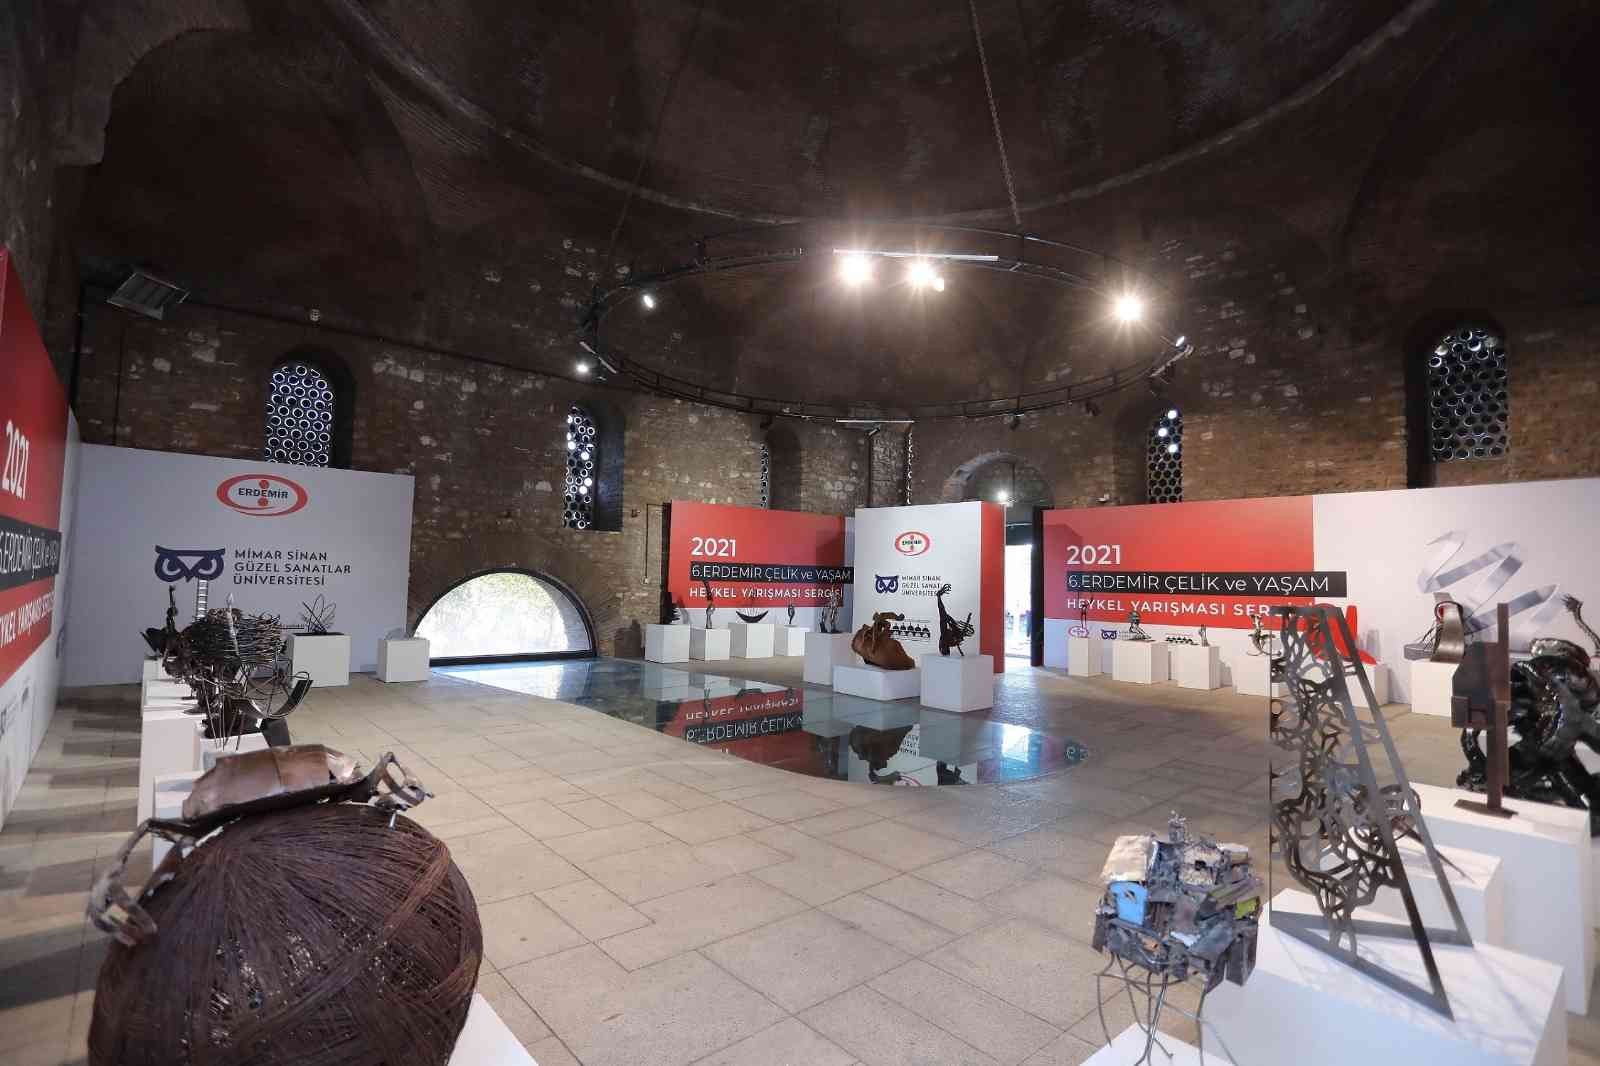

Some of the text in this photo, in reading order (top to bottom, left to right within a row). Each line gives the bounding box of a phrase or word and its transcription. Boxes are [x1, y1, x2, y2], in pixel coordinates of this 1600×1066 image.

[2, 419, 29, 500] 2021
[238, 488, 289, 499] ERDEMİR
[235, 548, 327, 560] MİMAR SİNAN
[691, 537, 736, 557] 2021
[1066, 544, 1120, 565] 2021
[234, 560, 351, 574] GÜZEL SANATLAR
[692, 564, 762, 579] 6.ERDEMİR
[765, 567, 798, 581] ÇELİK
[801, 571, 812, 580] ve
[233, 573, 325, 585] ÜNİVERSİTESİ
[1069, 573, 1329, 595] 6.ERDEMİR ÇELİK ve YAŞAM
[742, 588, 800, 600] YARIŞMASI
[1131, 601, 1225, 616] YARIŞMASI
